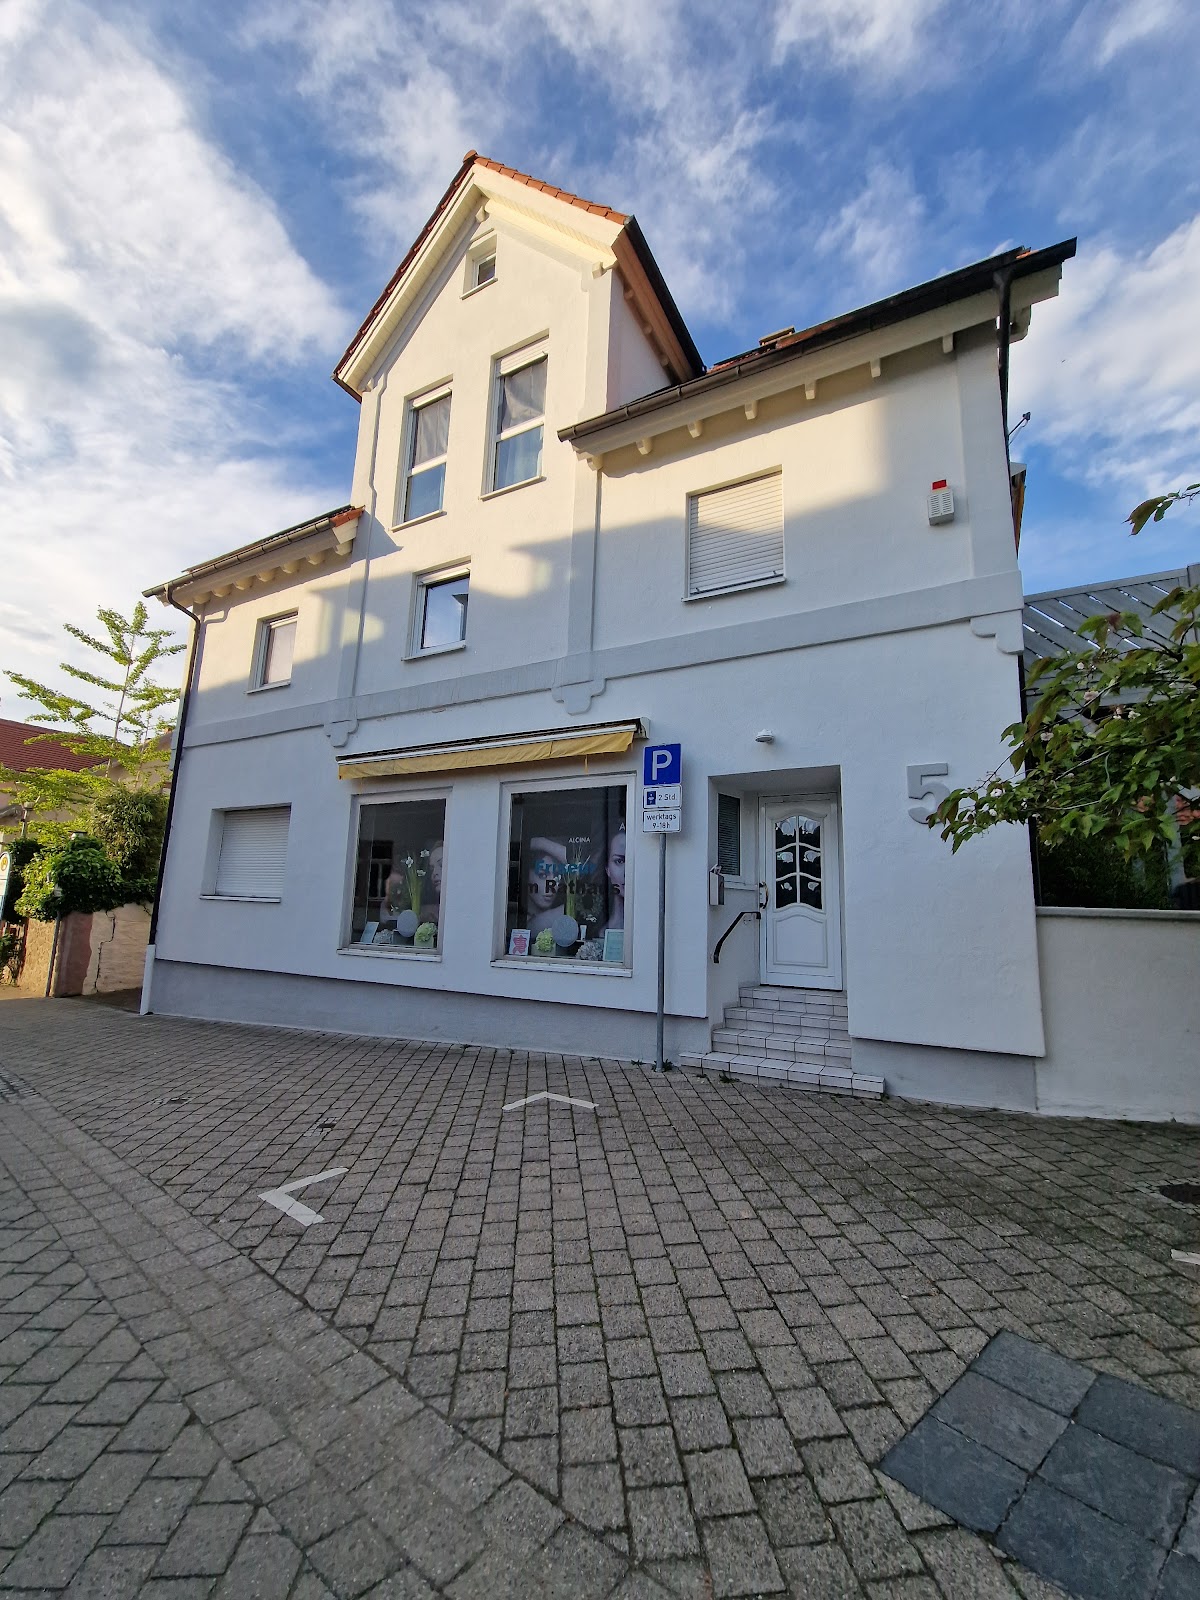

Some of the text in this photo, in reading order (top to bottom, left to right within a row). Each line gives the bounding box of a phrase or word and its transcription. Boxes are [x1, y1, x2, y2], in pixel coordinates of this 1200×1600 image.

[652, 749, 672, 780] P
[907, 763, 950, 824] 5
[646, 813, 677, 821] werktags
